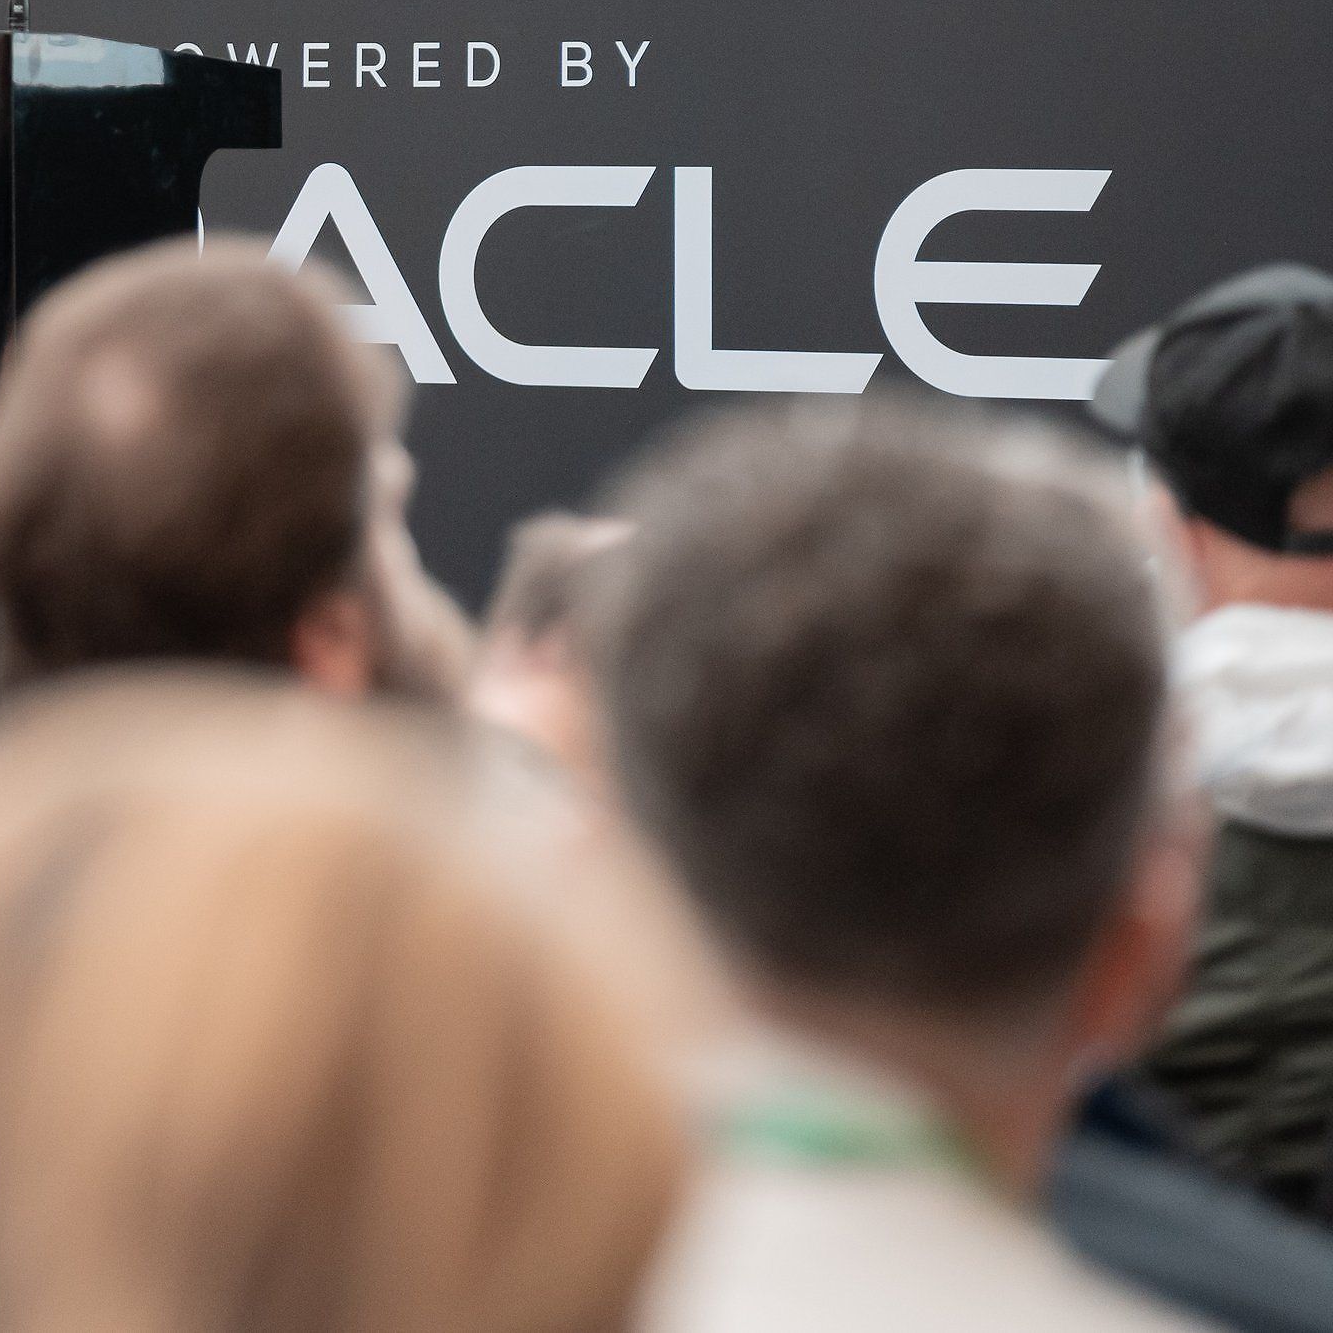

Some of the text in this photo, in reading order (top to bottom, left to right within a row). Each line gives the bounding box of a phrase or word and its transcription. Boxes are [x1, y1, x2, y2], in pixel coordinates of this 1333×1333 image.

[172, 40, 650, 88] WERED BY
[196, 162, 1115, 401] ACLE
